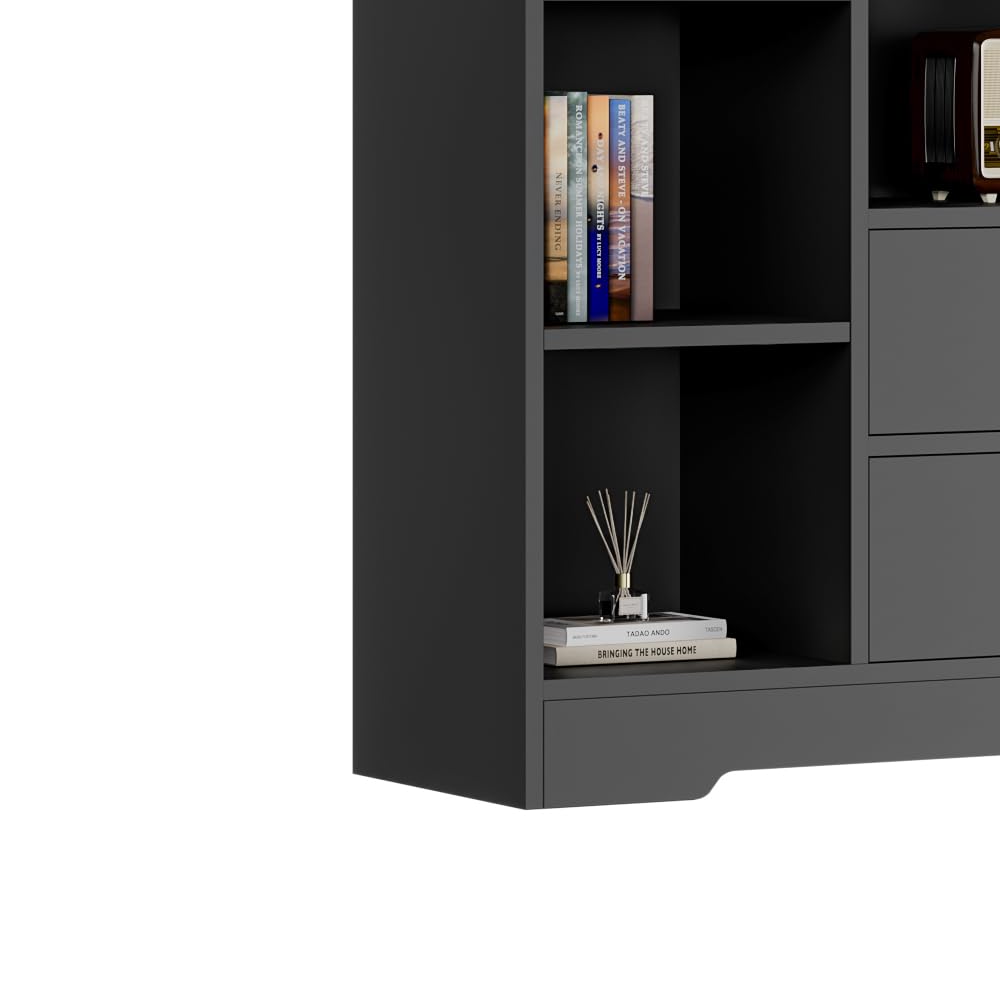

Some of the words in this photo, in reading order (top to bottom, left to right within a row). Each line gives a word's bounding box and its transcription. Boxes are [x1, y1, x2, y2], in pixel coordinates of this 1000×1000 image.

[617, 104, 626, 137] BEATY
[617, 139, 626, 162] AND
[555, 172, 563, 207] NEVER
[575, 177, 583, 217] SUMMER
[617, 165, 626, 197] STEVE
[554, 208, 562, 251] ENDING
[617, 206, 626, 222] ON
[575, 220, 583, 268] HOLIDAYS
[617, 225, 626, 281] VACATION
[626, 630, 649, 638] TADAO
[650, 629, 670, 637] ANDO
[597, 648, 633, 659] BRINGING
[635, 648, 649, 657] THE
[650, 646, 675, 656] HOUSE
[676, 645, 697, 655] HOME
